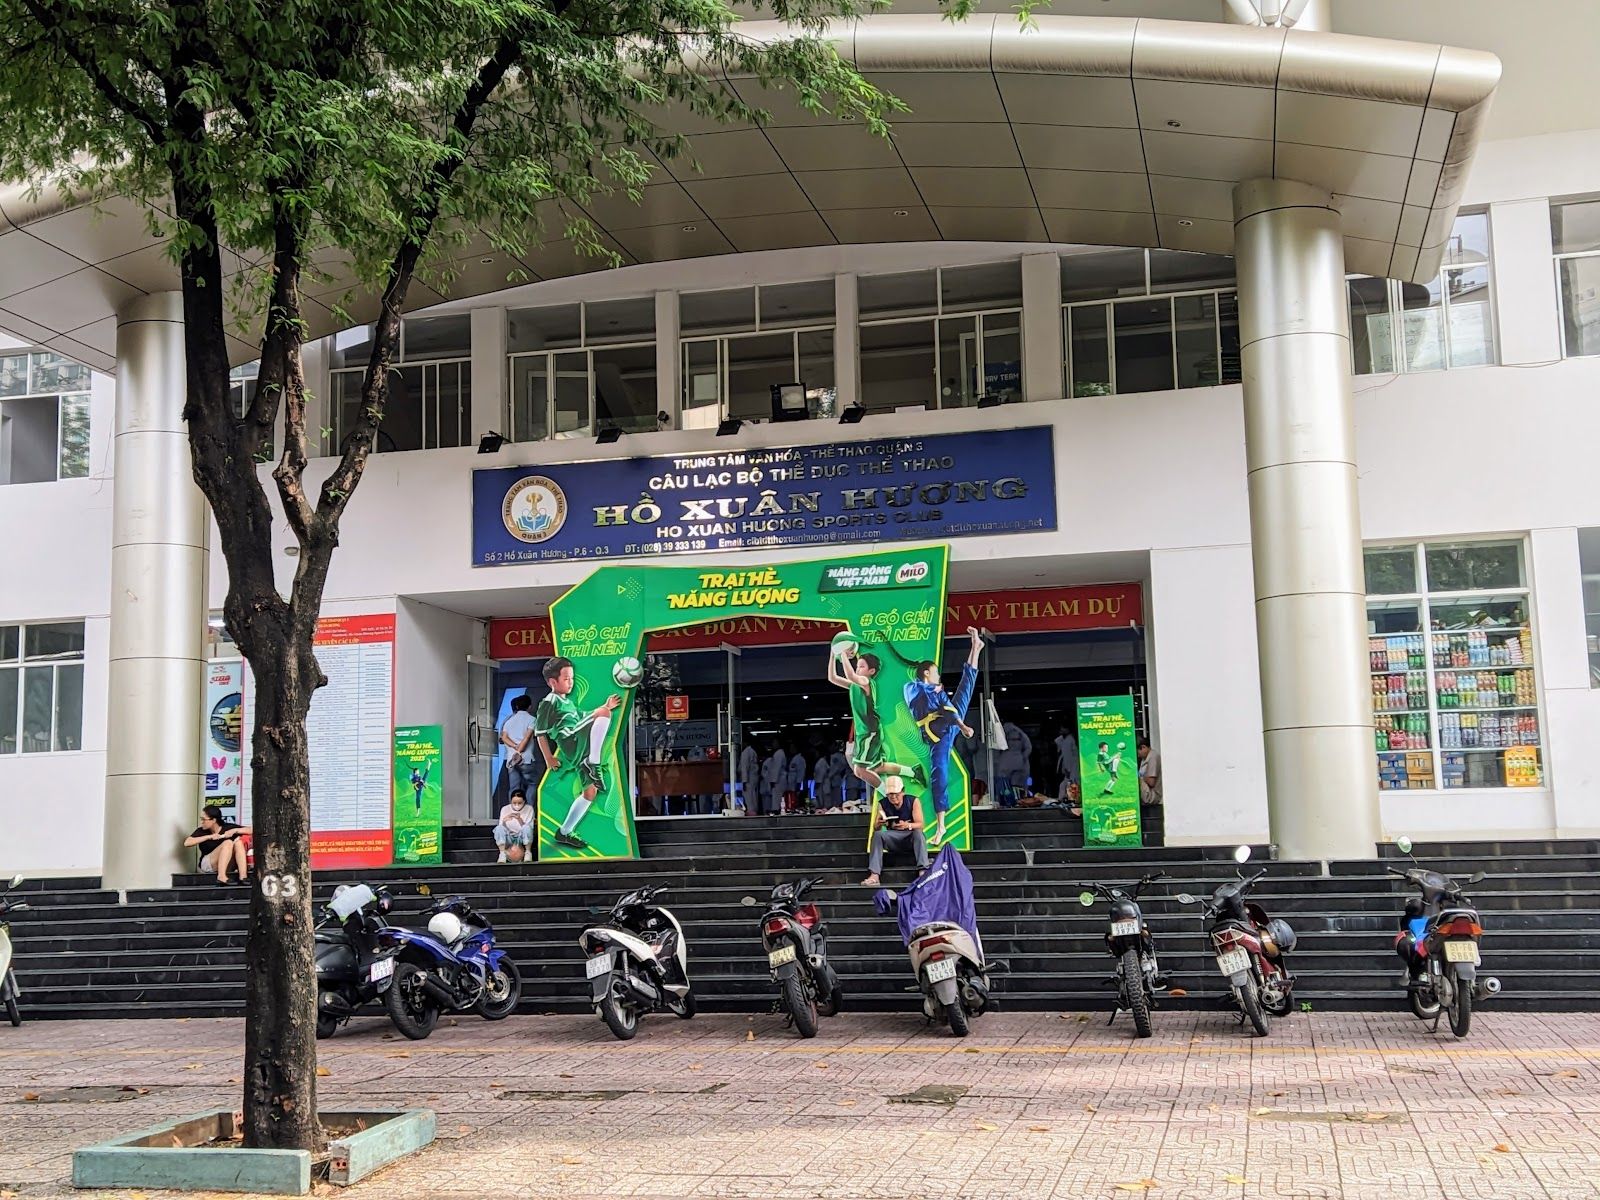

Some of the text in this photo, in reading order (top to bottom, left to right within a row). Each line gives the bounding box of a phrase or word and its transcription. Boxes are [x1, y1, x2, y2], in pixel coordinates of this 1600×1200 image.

[674, 457, 716, 470] TRUNG
[718, 453, 745, 468] TÂM
[748, 452, 773, 464] VĂN
[775, 449, 801, 462] HÓA
[811, 444, 835, 459] THỂ
[838, 446, 872, 457] THAO
[876, 441, 913, 455] QUẬN
[916, 442, 923, 451] 3
[649, 455, 955, 490] CÂU LẠC BỘ THỂ DỤC THỂ THAO
[592, 477, 1030, 527] HỒ XUÂN HƯƠNG
[656, 509, 944, 538] HO XUAN HUONG SPORTS CLUB
[484, 551, 496, 562] Số
[498, 553, 503, 561] 2
[517, 549, 538, 560] Xuân
[541, 548, 567, 559] Hương
[574, 547, 587, 556] P.6
[595, 546, 609, 555] Q.3
[625, 540, 706, 553] ĐT: (028) 39 333 139
[746, 567, 782, 586] HÈ
[826, 564, 893, 578] NĂNG ĐỘNG
[900, 568, 925, 578] MILO
[835, 575, 889, 588] VIỆT NAM
[666, 588, 800, 609] NĂNG LƯỢNG
[504, 624, 551, 646] CHÀ
[968, 599, 1000, 621] VỀ
[1006, 600, 1080, 619] THAM
[1087, 594, 1126, 618] DỰ
[902, 607, 935, 624] CHÍ
[600, 622, 631, 640] CHÍ
[893, 624, 931, 641] NÊN
[591, 640, 627, 656] NÊN
[206, 797, 234, 806] andro
[261, 874, 297, 897] 63
